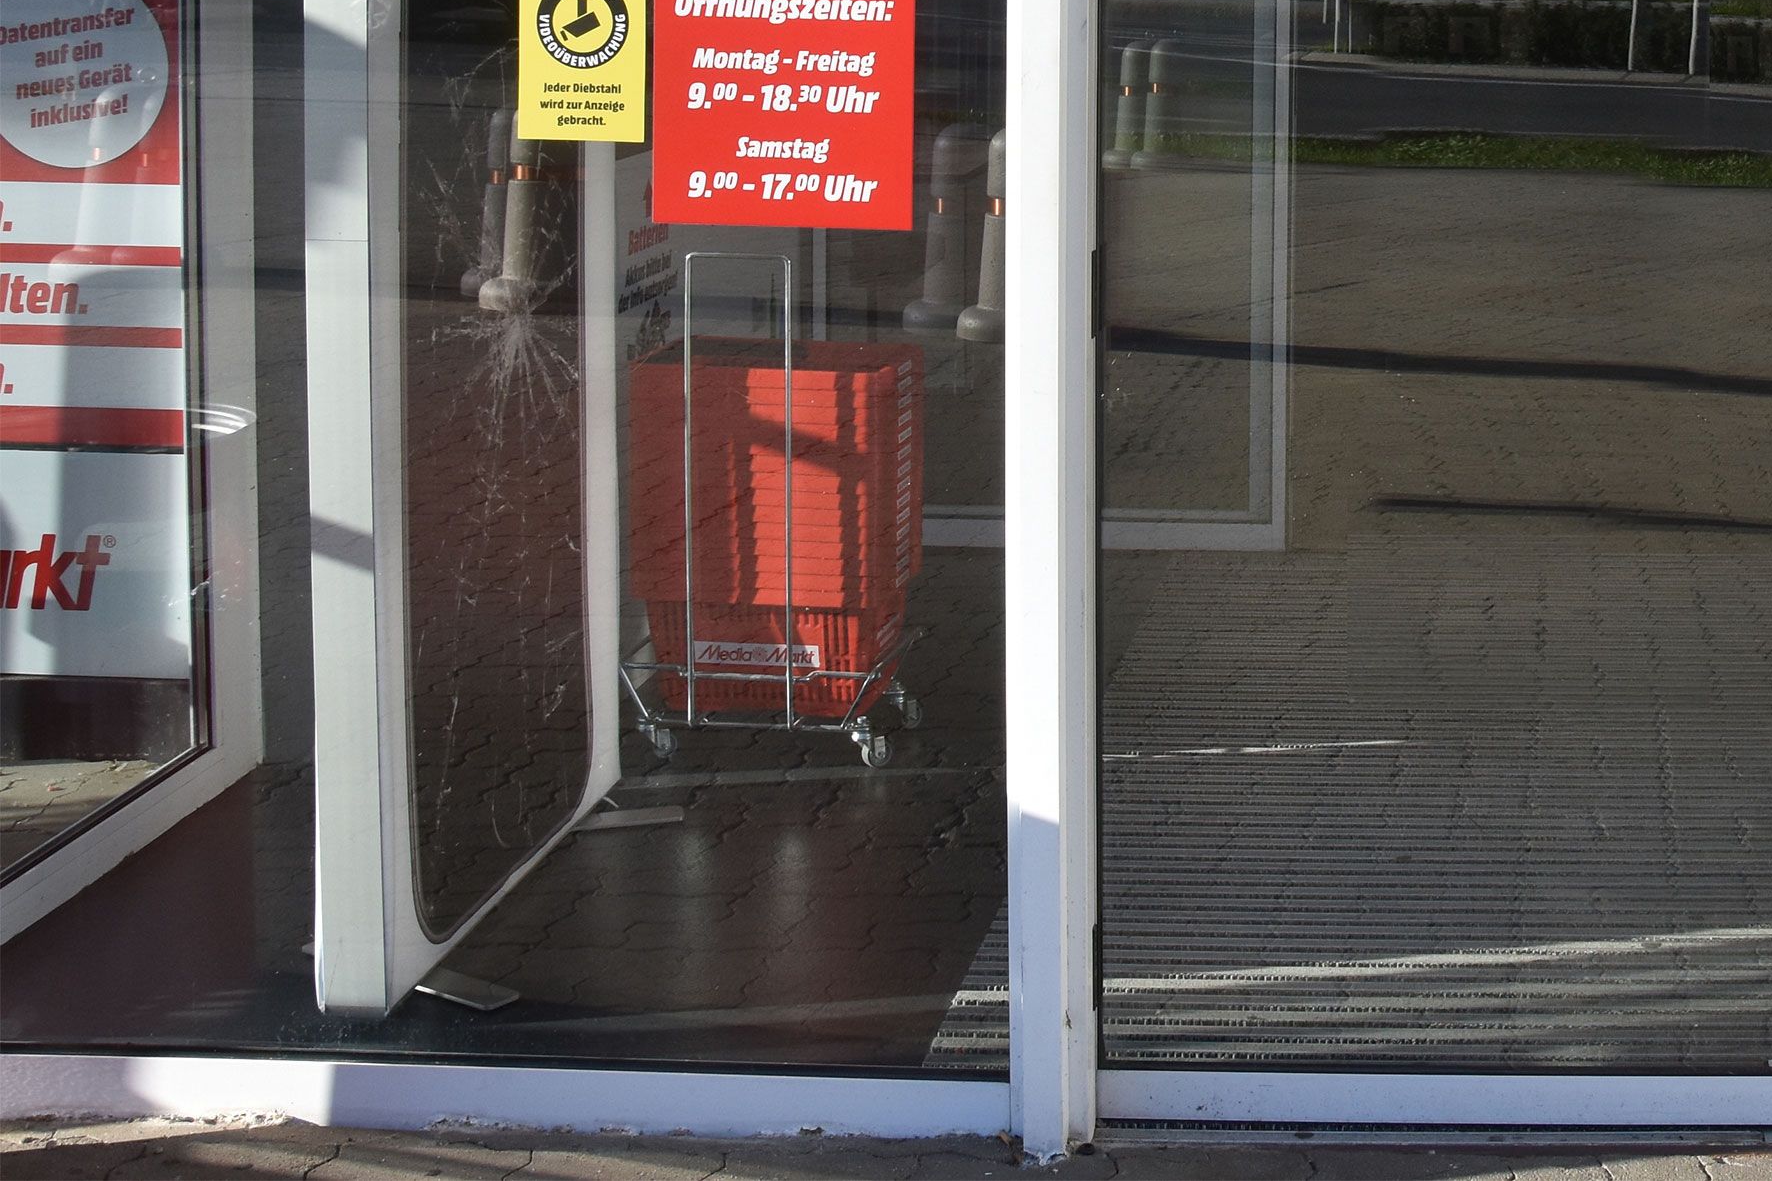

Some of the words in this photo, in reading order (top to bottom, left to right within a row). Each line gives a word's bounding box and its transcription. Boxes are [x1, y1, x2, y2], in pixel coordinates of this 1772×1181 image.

[0, 7, 135, 44] Datentransfer
[539, 13, 626, 68] VIDEOÜBERWACHUNG
[34, 44, 69, 68] auf
[72, 40, 104, 62] ein
[692, 47, 780, 75] Montag
[795, 50, 876, 77] Freitag
[16, 73, 75, 100] neues
[78, 63, 133, 89] Gerät
[543, 83, 571, 93] Jeder
[573, 83, 621, 94] Diebstahl
[30, 93, 129, 128] inklusive!
[540, 99, 564, 109] wird
[566, 100, 582, 110] zur
[584, 100, 625, 113] Anzeige
[687, 82, 738, 110] 9.00
[760, 84, 822, 112] 18.30
[825, 85, 880, 114] Uhr
[557, 115, 606, 126] gebracht.
[735, 136, 830, 164] Samstag
[687, 170, 738, 198] 9.00
[760, 173, 820, 201] 17.00
[823, 174, 878, 203] Uhr
[698, 644, 752, 661] Media
